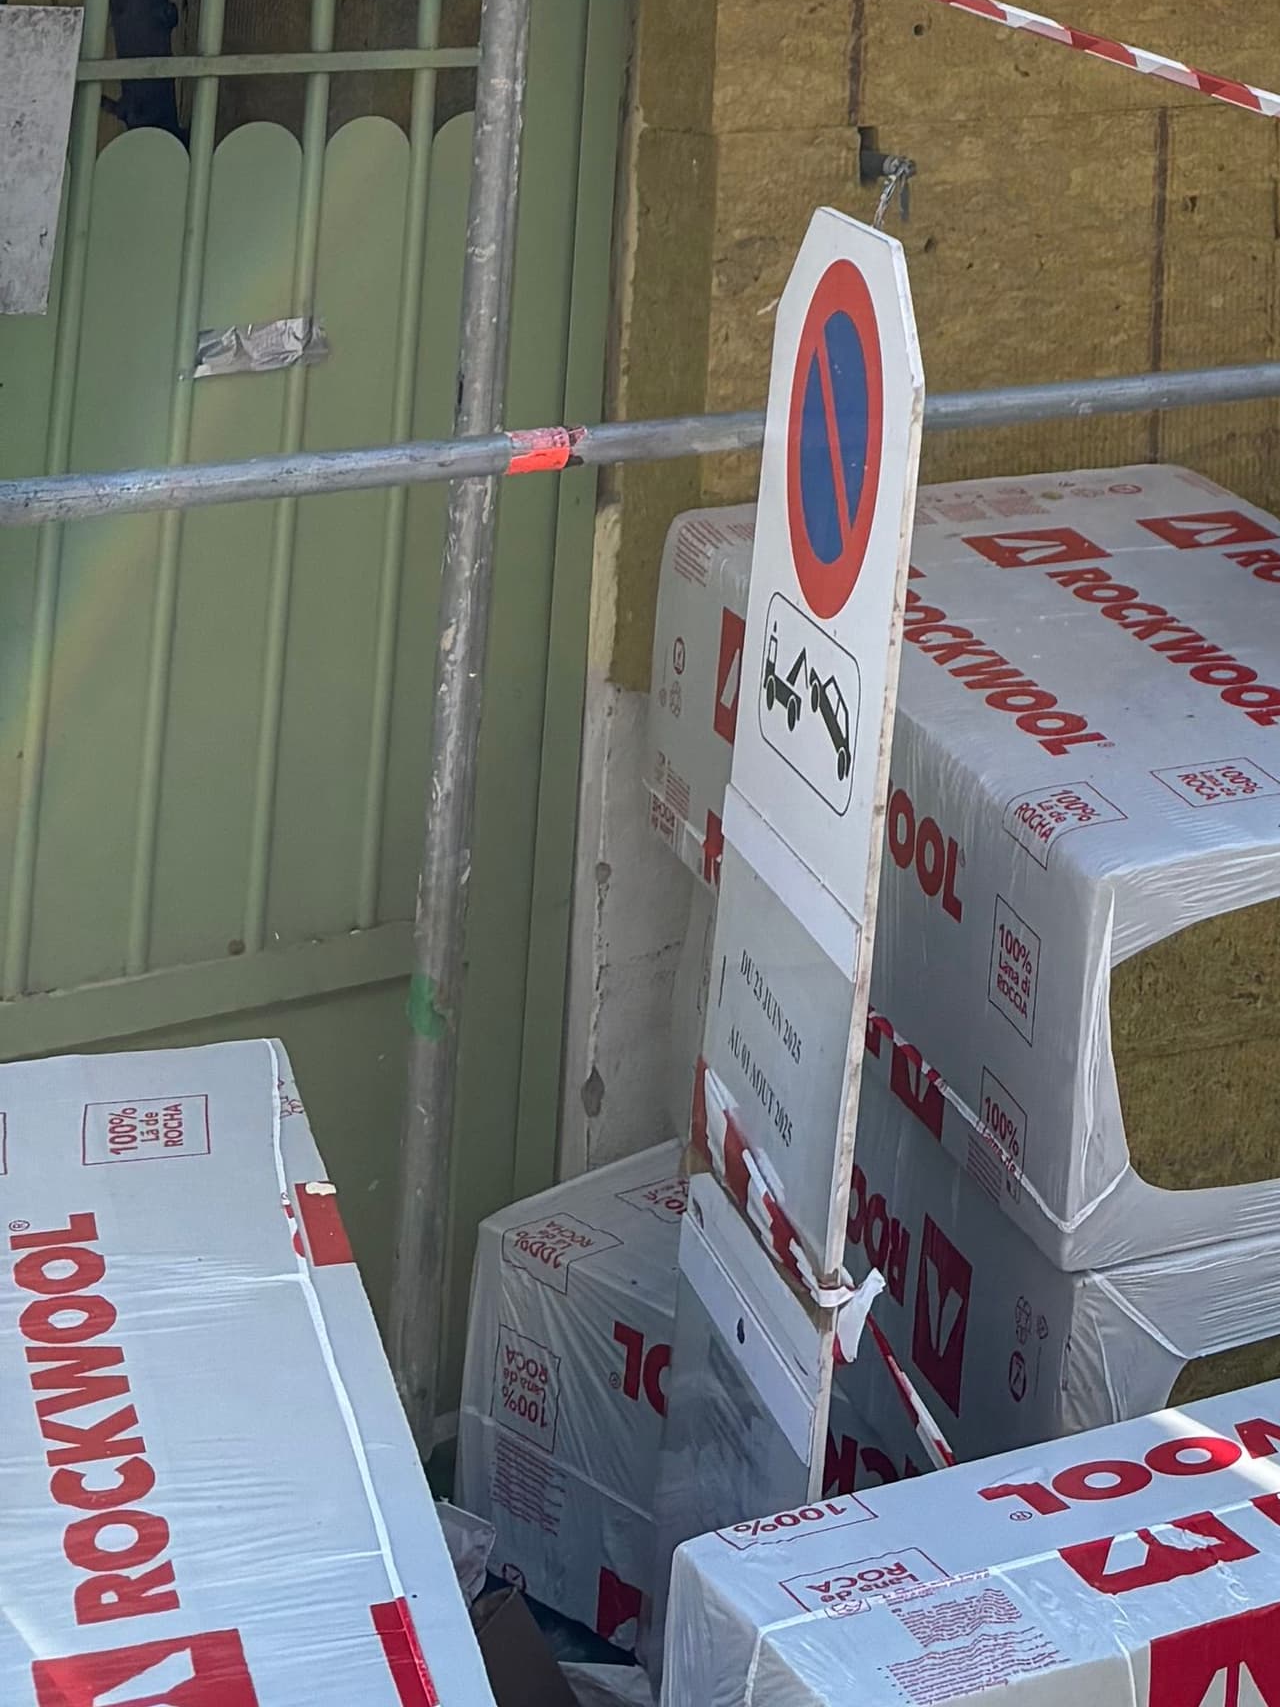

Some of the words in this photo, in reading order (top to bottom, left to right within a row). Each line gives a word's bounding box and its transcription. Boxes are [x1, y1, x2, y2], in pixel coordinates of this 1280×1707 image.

[1177, 773, 1221, 801] ROCA
[1216, 765, 1263, 794] 100%
[1014, 801, 1056, 844] ROCHA
[1049, 810, 1068, 824] de
[1050, 789, 1101, 823] 100%
[998, 923, 1033, 976] 100%
[998, 954, 1021, 988] Lana
[1020, 970, 1031, 997] di
[739, 948, 756, 986] DU
[753, 970, 763, 1002] 23
[762, 991, 783, 1039] JUIN
[782, 1018, 802, 1065] 2025
[728, 1024, 741, 1059] AU
[774, 1100, 793, 1148] 2025
[109, 1107, 137, 1155] 100%
[139, 1111, 159, 1126] de
[163, 1103, 184, 1148] ROCHA
[985, 1096, 1020, 1158] 100%
[503, 1367, 518, 1386] de
[505, 1345, 548, 1385] ROCA
[9, 1211, 181, 1626] ROCKWOOL
[502, 1385, 548, 1428] 100%
[733, 1503, 847, 1536] 100%
[805, 1562, 912, 1594] ROCA
[821, 1590, 853, 1603] de
[859, 1570, 920, 1593] Lana
